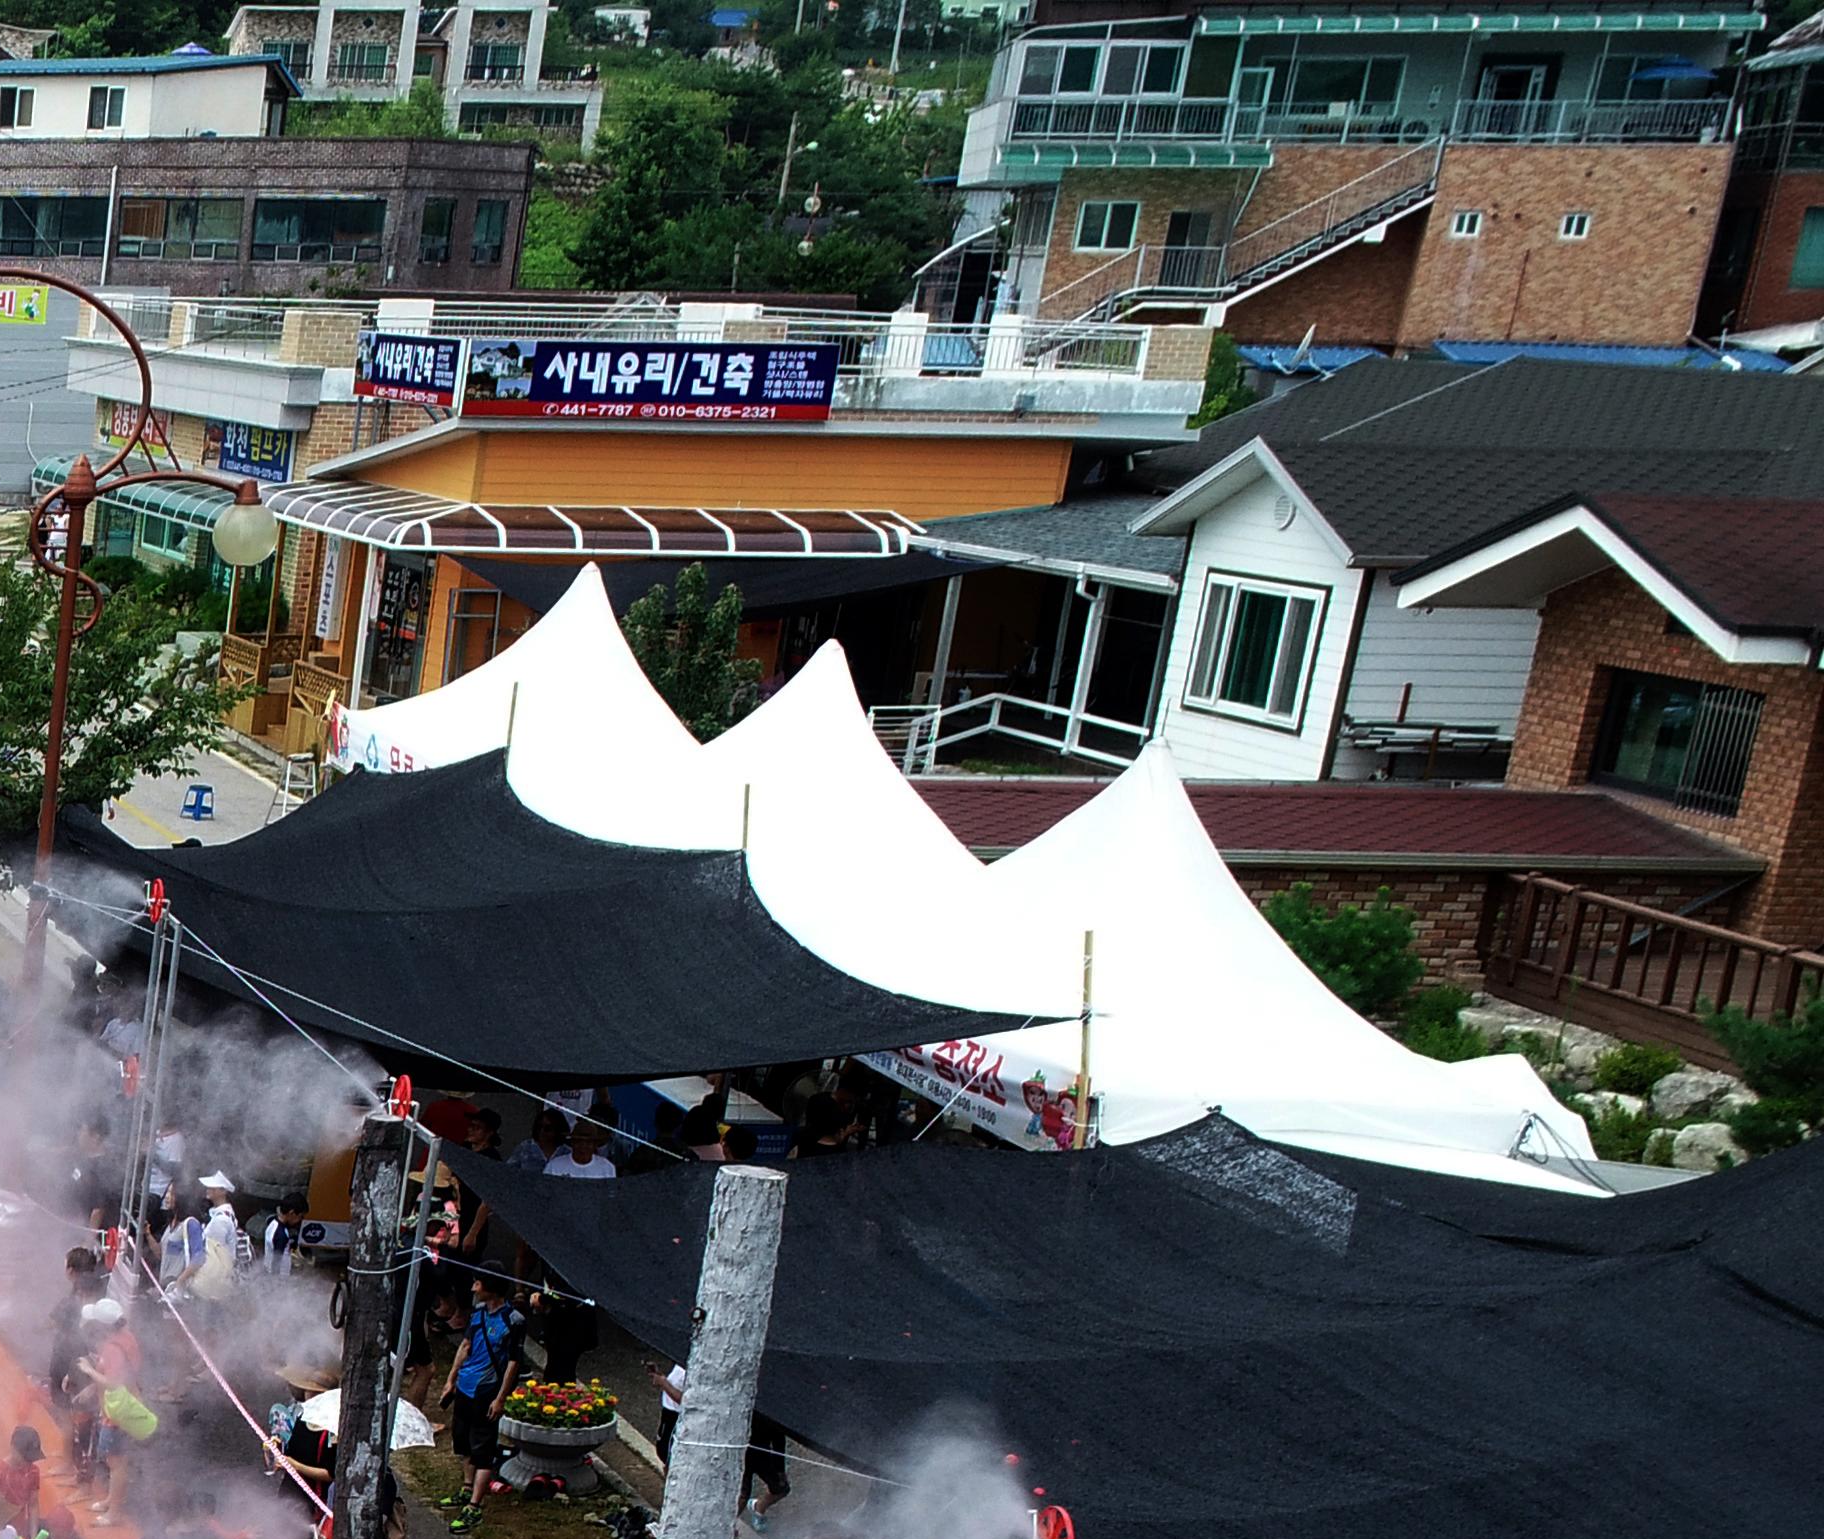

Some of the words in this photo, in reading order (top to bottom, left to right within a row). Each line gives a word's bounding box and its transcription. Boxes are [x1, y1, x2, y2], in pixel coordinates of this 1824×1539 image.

[374, 341, 436, 385] 사내유리/건축
[767, 350, 818, 361] 조립식주택
[543, 350, 755, 397] 사내유리/건축
[559, 404, 634, 417] 441-7787
[658, 404, 777, 419] 010-6375-2321
